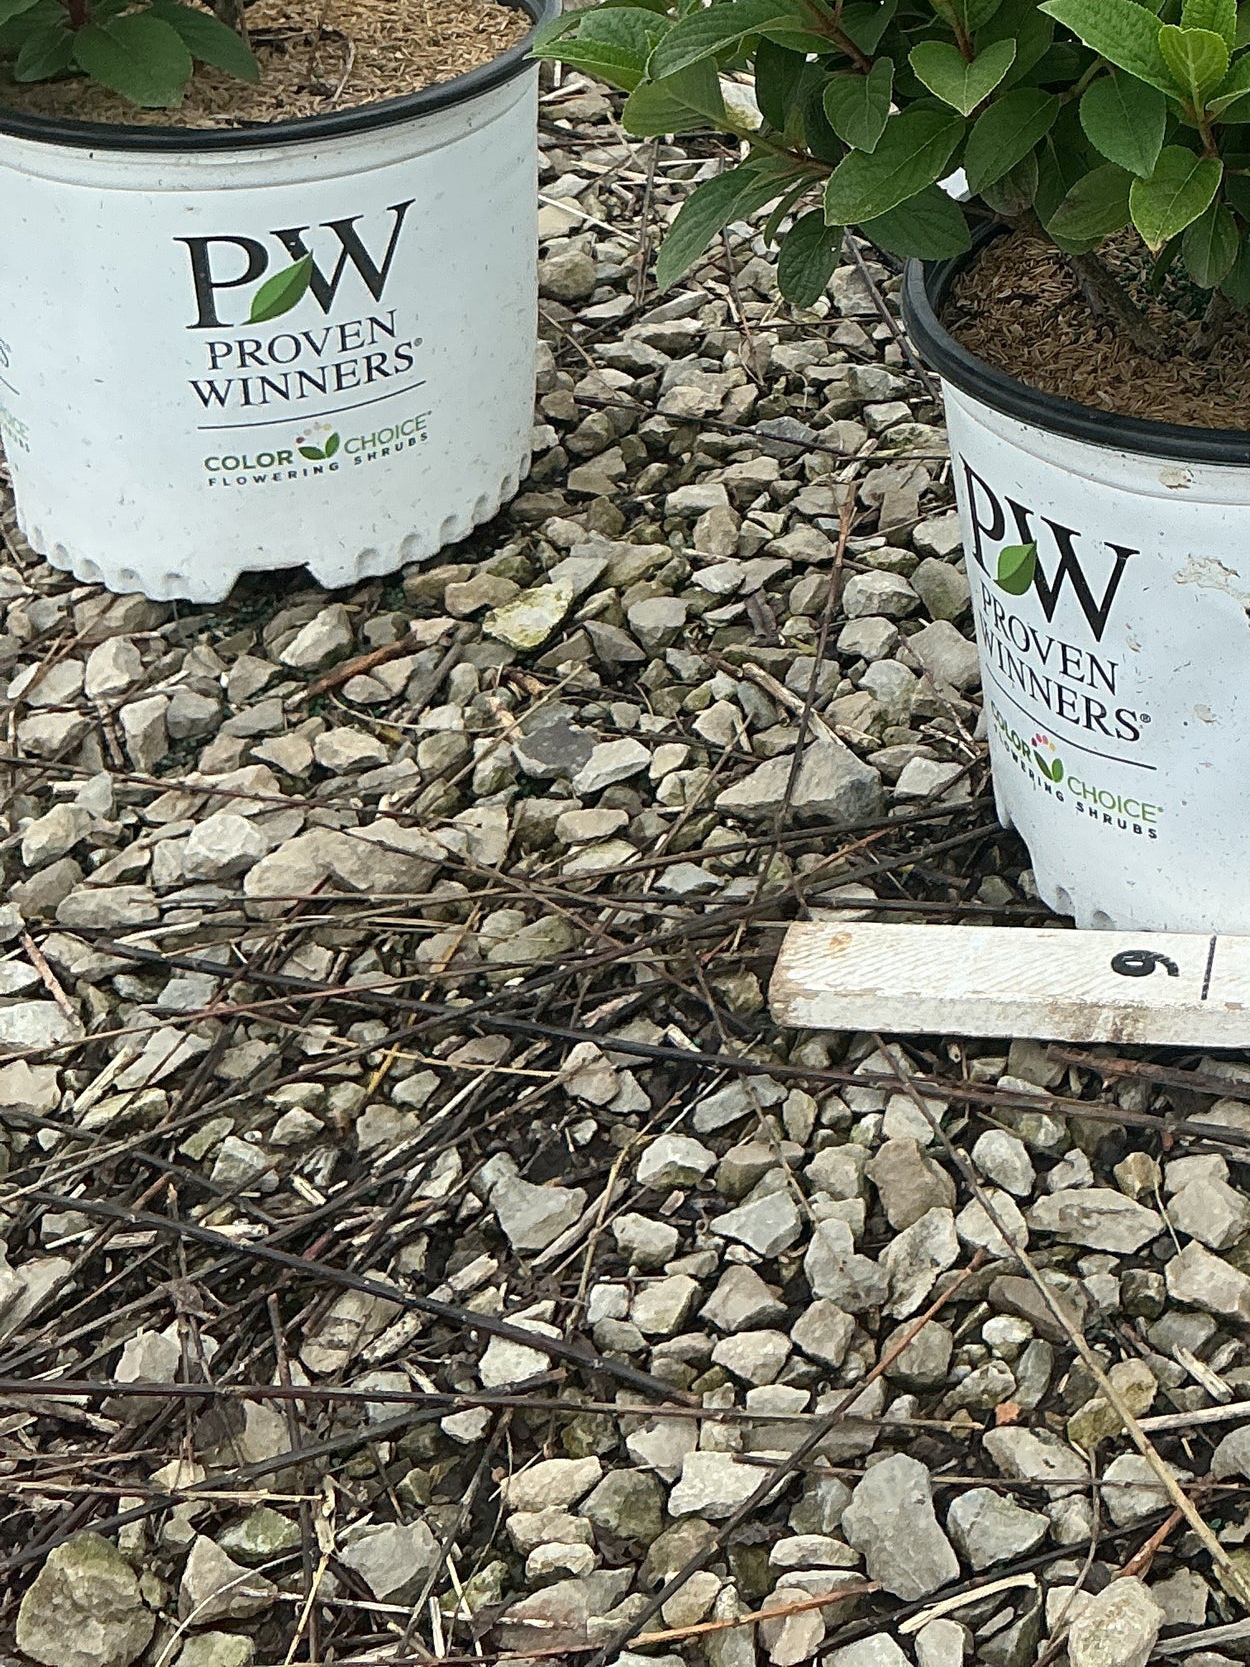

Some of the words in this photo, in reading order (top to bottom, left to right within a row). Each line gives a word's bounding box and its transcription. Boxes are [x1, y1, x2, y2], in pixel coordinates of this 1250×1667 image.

[173, 198, 416, 329] PW
[206, 309, 397, 370] PROVEN
[204, 450, 293, 472] COLOR
[208, 461, 339, 486] FLOWERING
[354, 432, 428, 465] SHRUBS
[959, 452, 1140, 642] PW
[981, 581, 1119, 695] PROVEN
[991, 700, 1032, 763] COLOR
[1076, 801, 1157, 839] SHRUBS
[1110, 949, 1180, 977] 6
